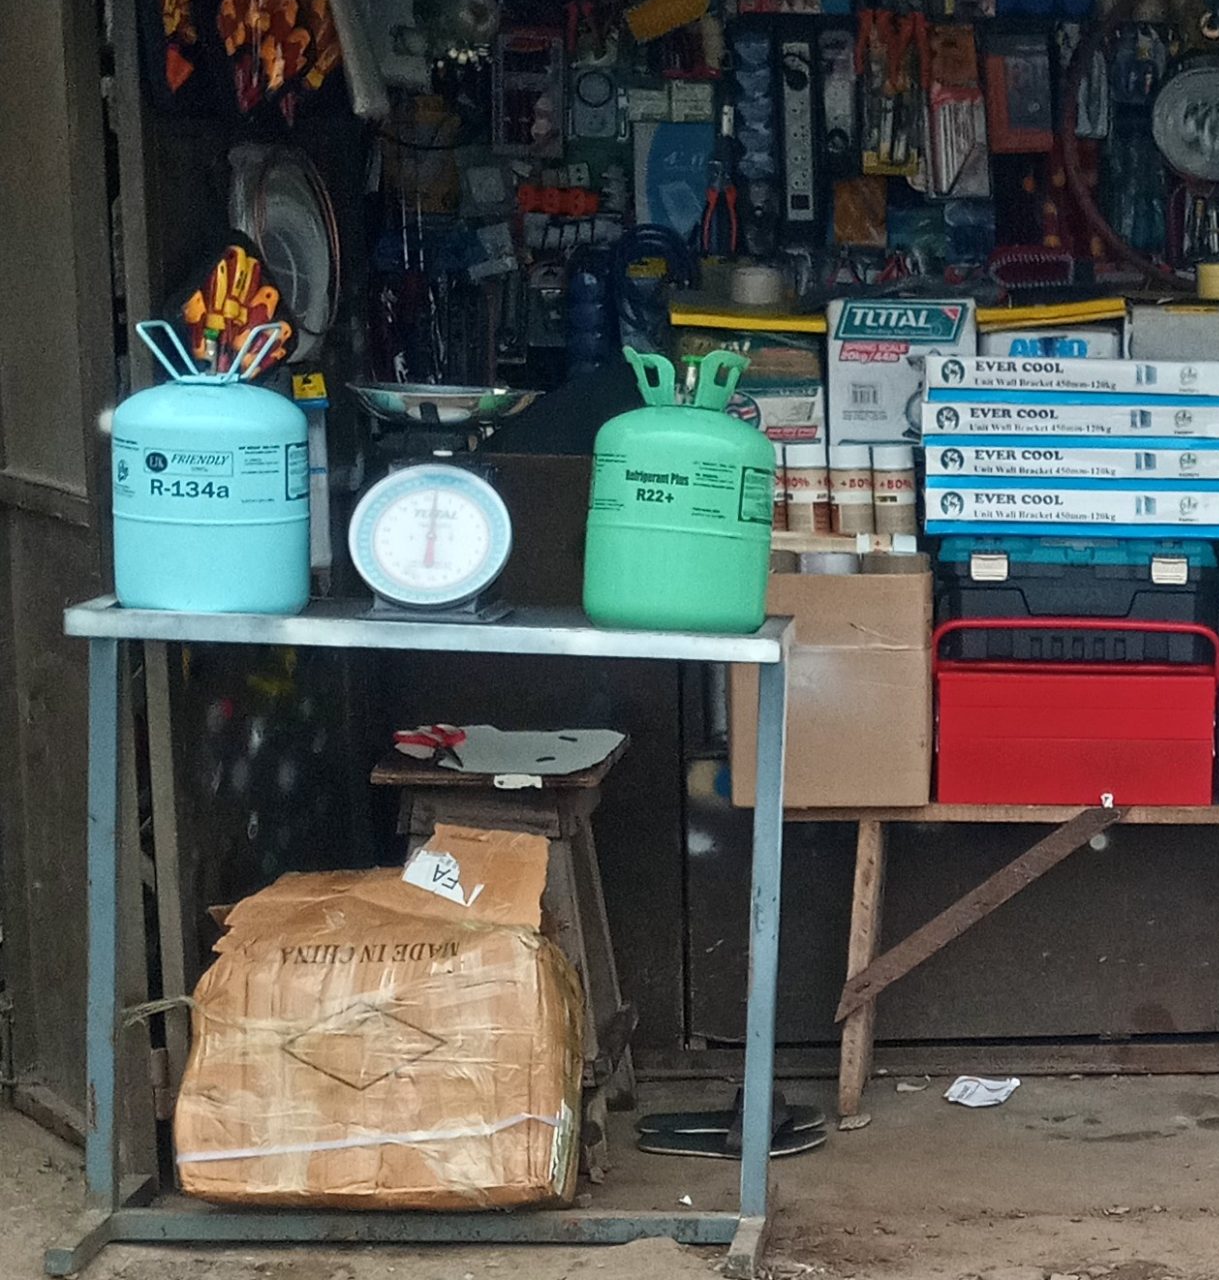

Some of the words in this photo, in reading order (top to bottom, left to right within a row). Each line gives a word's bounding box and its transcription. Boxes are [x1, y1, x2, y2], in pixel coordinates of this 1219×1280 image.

[851, 308, 932, 328] TOTAL
[975, 361, 1017, 372] EVER
[1022, 361, 1064, 374] COOL
[970, 407, 1012, 419] EVER
[1017, 408, 1059, 420] COOL
[171, 453, 230, 466] FRIENDLY
[974, 449, 1017, 460] EVER
[1021, 450, 1063, 461] COOL
[625, 469, 669, 484] Refrigerant
[671, 472, 689, 486] Plus
[150, 478, 230, 499] R-134a
[636, 488, 674, 503] R22+
[974, 493, 1017, 504] EVER
[1021, 494, 1063, 505] COOL
[280, 943, 356, 966] CHINA
[359, 942, 385, 964] IN
[391, 941, 461, 963] MADE
